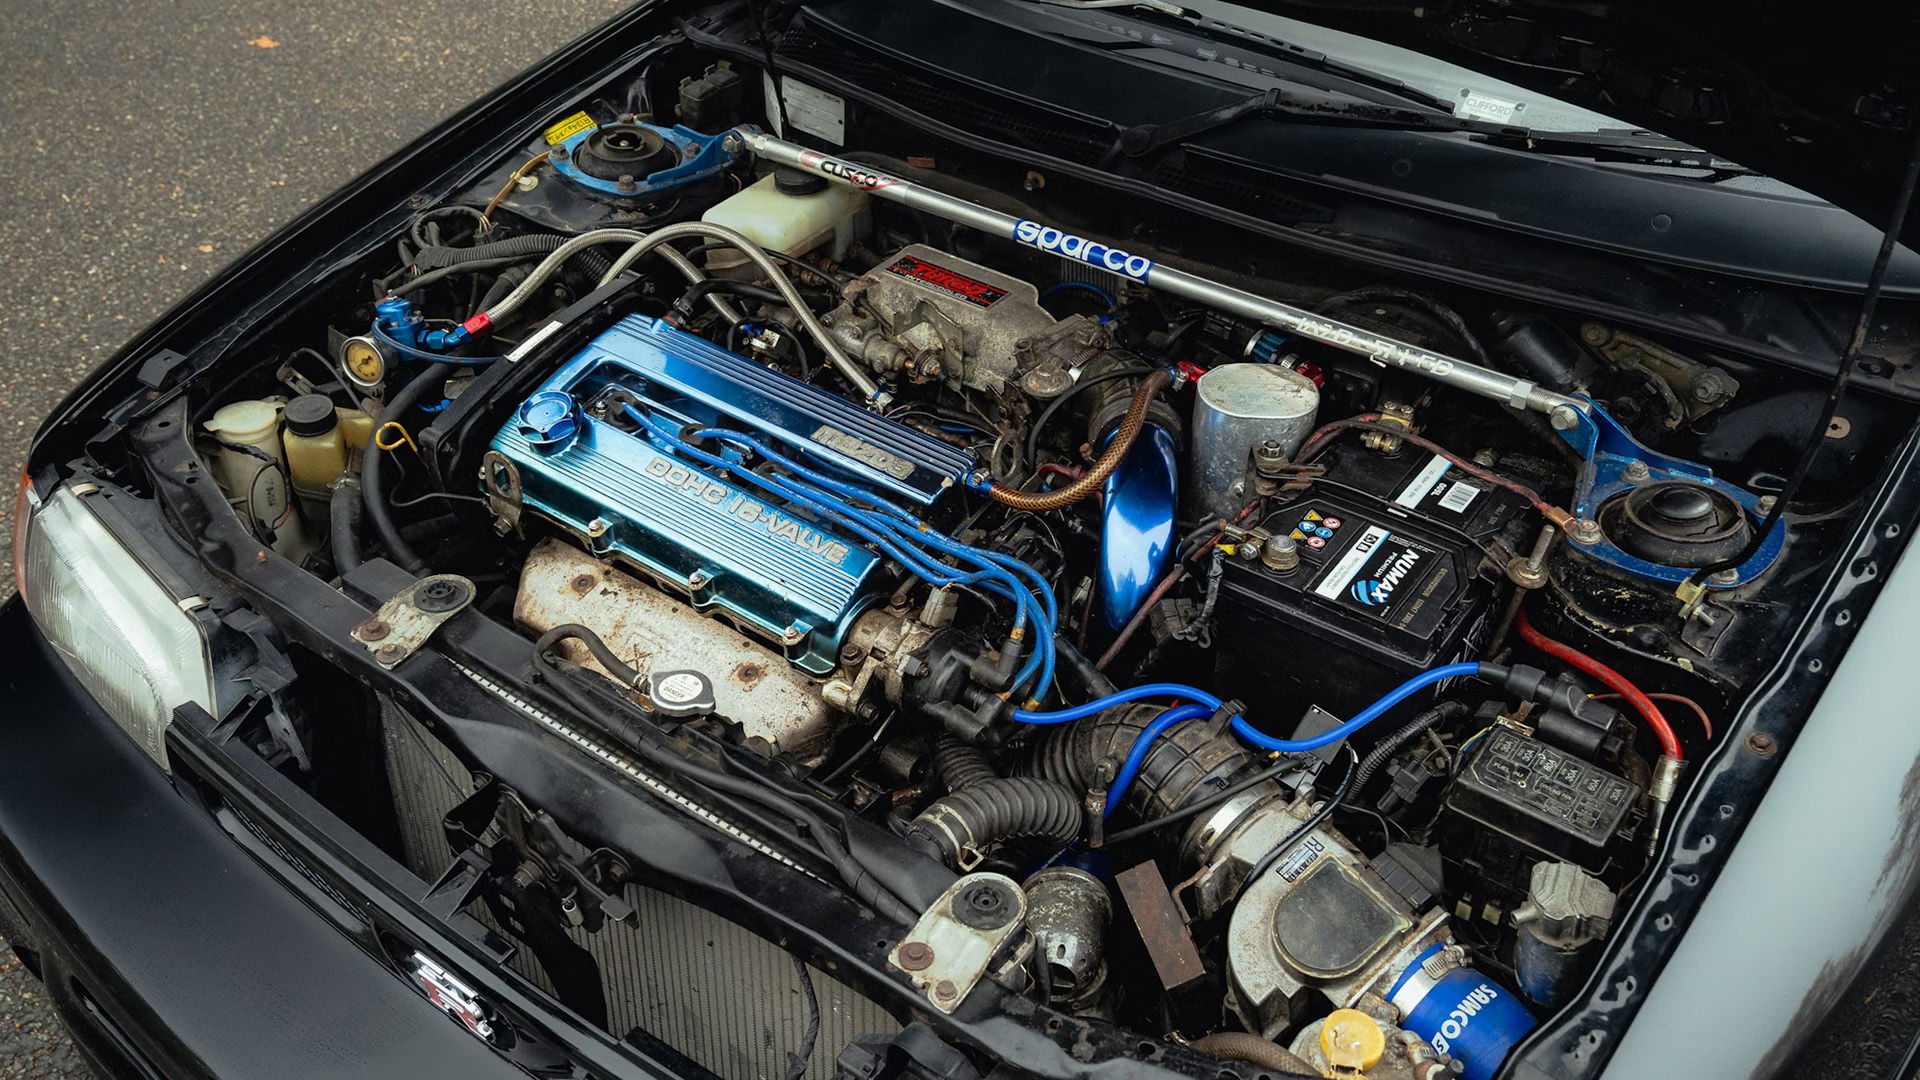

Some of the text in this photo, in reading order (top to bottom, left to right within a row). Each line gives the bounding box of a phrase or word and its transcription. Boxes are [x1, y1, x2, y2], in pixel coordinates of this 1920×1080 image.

[1466, 98, 1512, 116] CLIFFORD
[820, 160, 878, 188] CUSCO
[1016, 220, 1151, 278] sparco
[645, 456, 849, 566] DOHC 16-VALVE
[1371, 547, 1420, 604] NUMAX
[1373, 551, 1398, 578] PREMIUM
[1492, 761, 1511, 773] FUEL
[1440, 983, 1498, 1040] SAMCO
